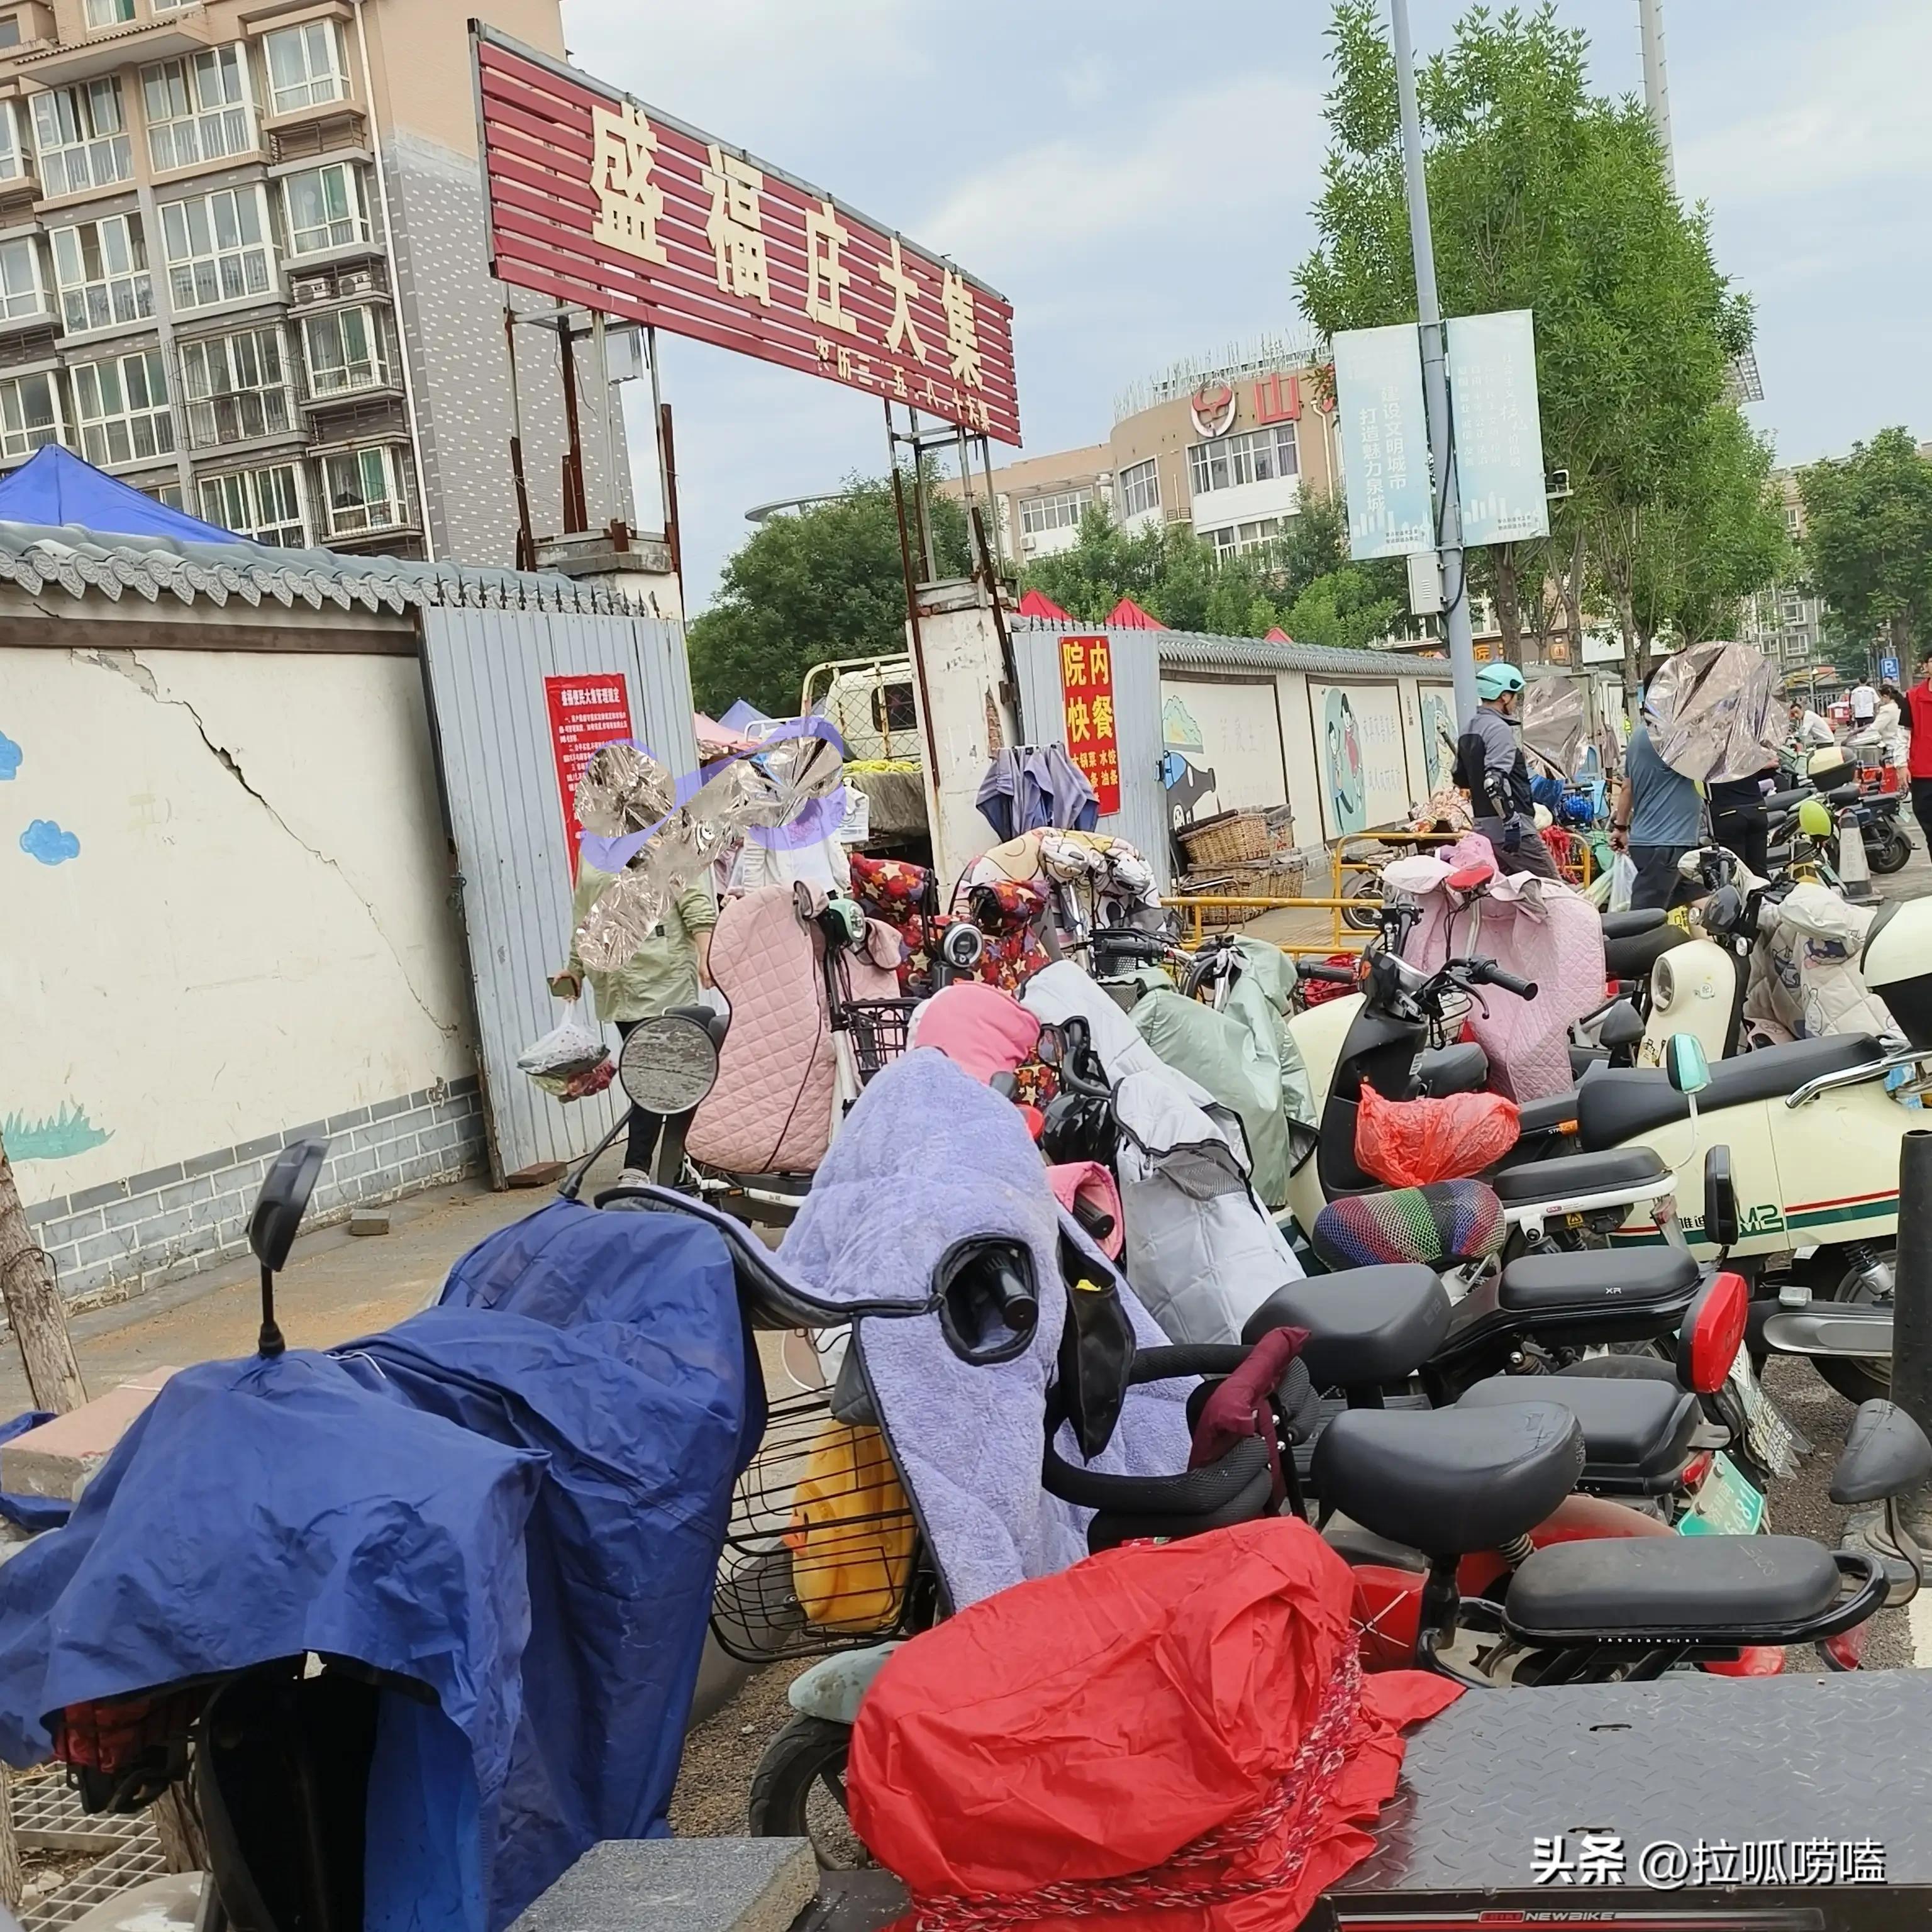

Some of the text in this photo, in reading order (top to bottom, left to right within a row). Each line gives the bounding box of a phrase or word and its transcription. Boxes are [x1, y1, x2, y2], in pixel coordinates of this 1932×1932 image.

[591, 101, 983, 391] 盛福庄大集
[1255, 373, 1301, 425] 山
[1359, 408, 1386, 512] 打造魅力泉城
[1381, 386, 1407, 490] 建设文明城市
[1063, 640, 1109, 687] 院内
[1068, 694, 1113, 743] 快餐
[1099, 748, 1116, 766] 水饺
[1101, 770, 1118, 786] 油条
[1739, 1204, 1784, 1233] M2
[1526, 1912, 1614, 1921] NEWBIKE
